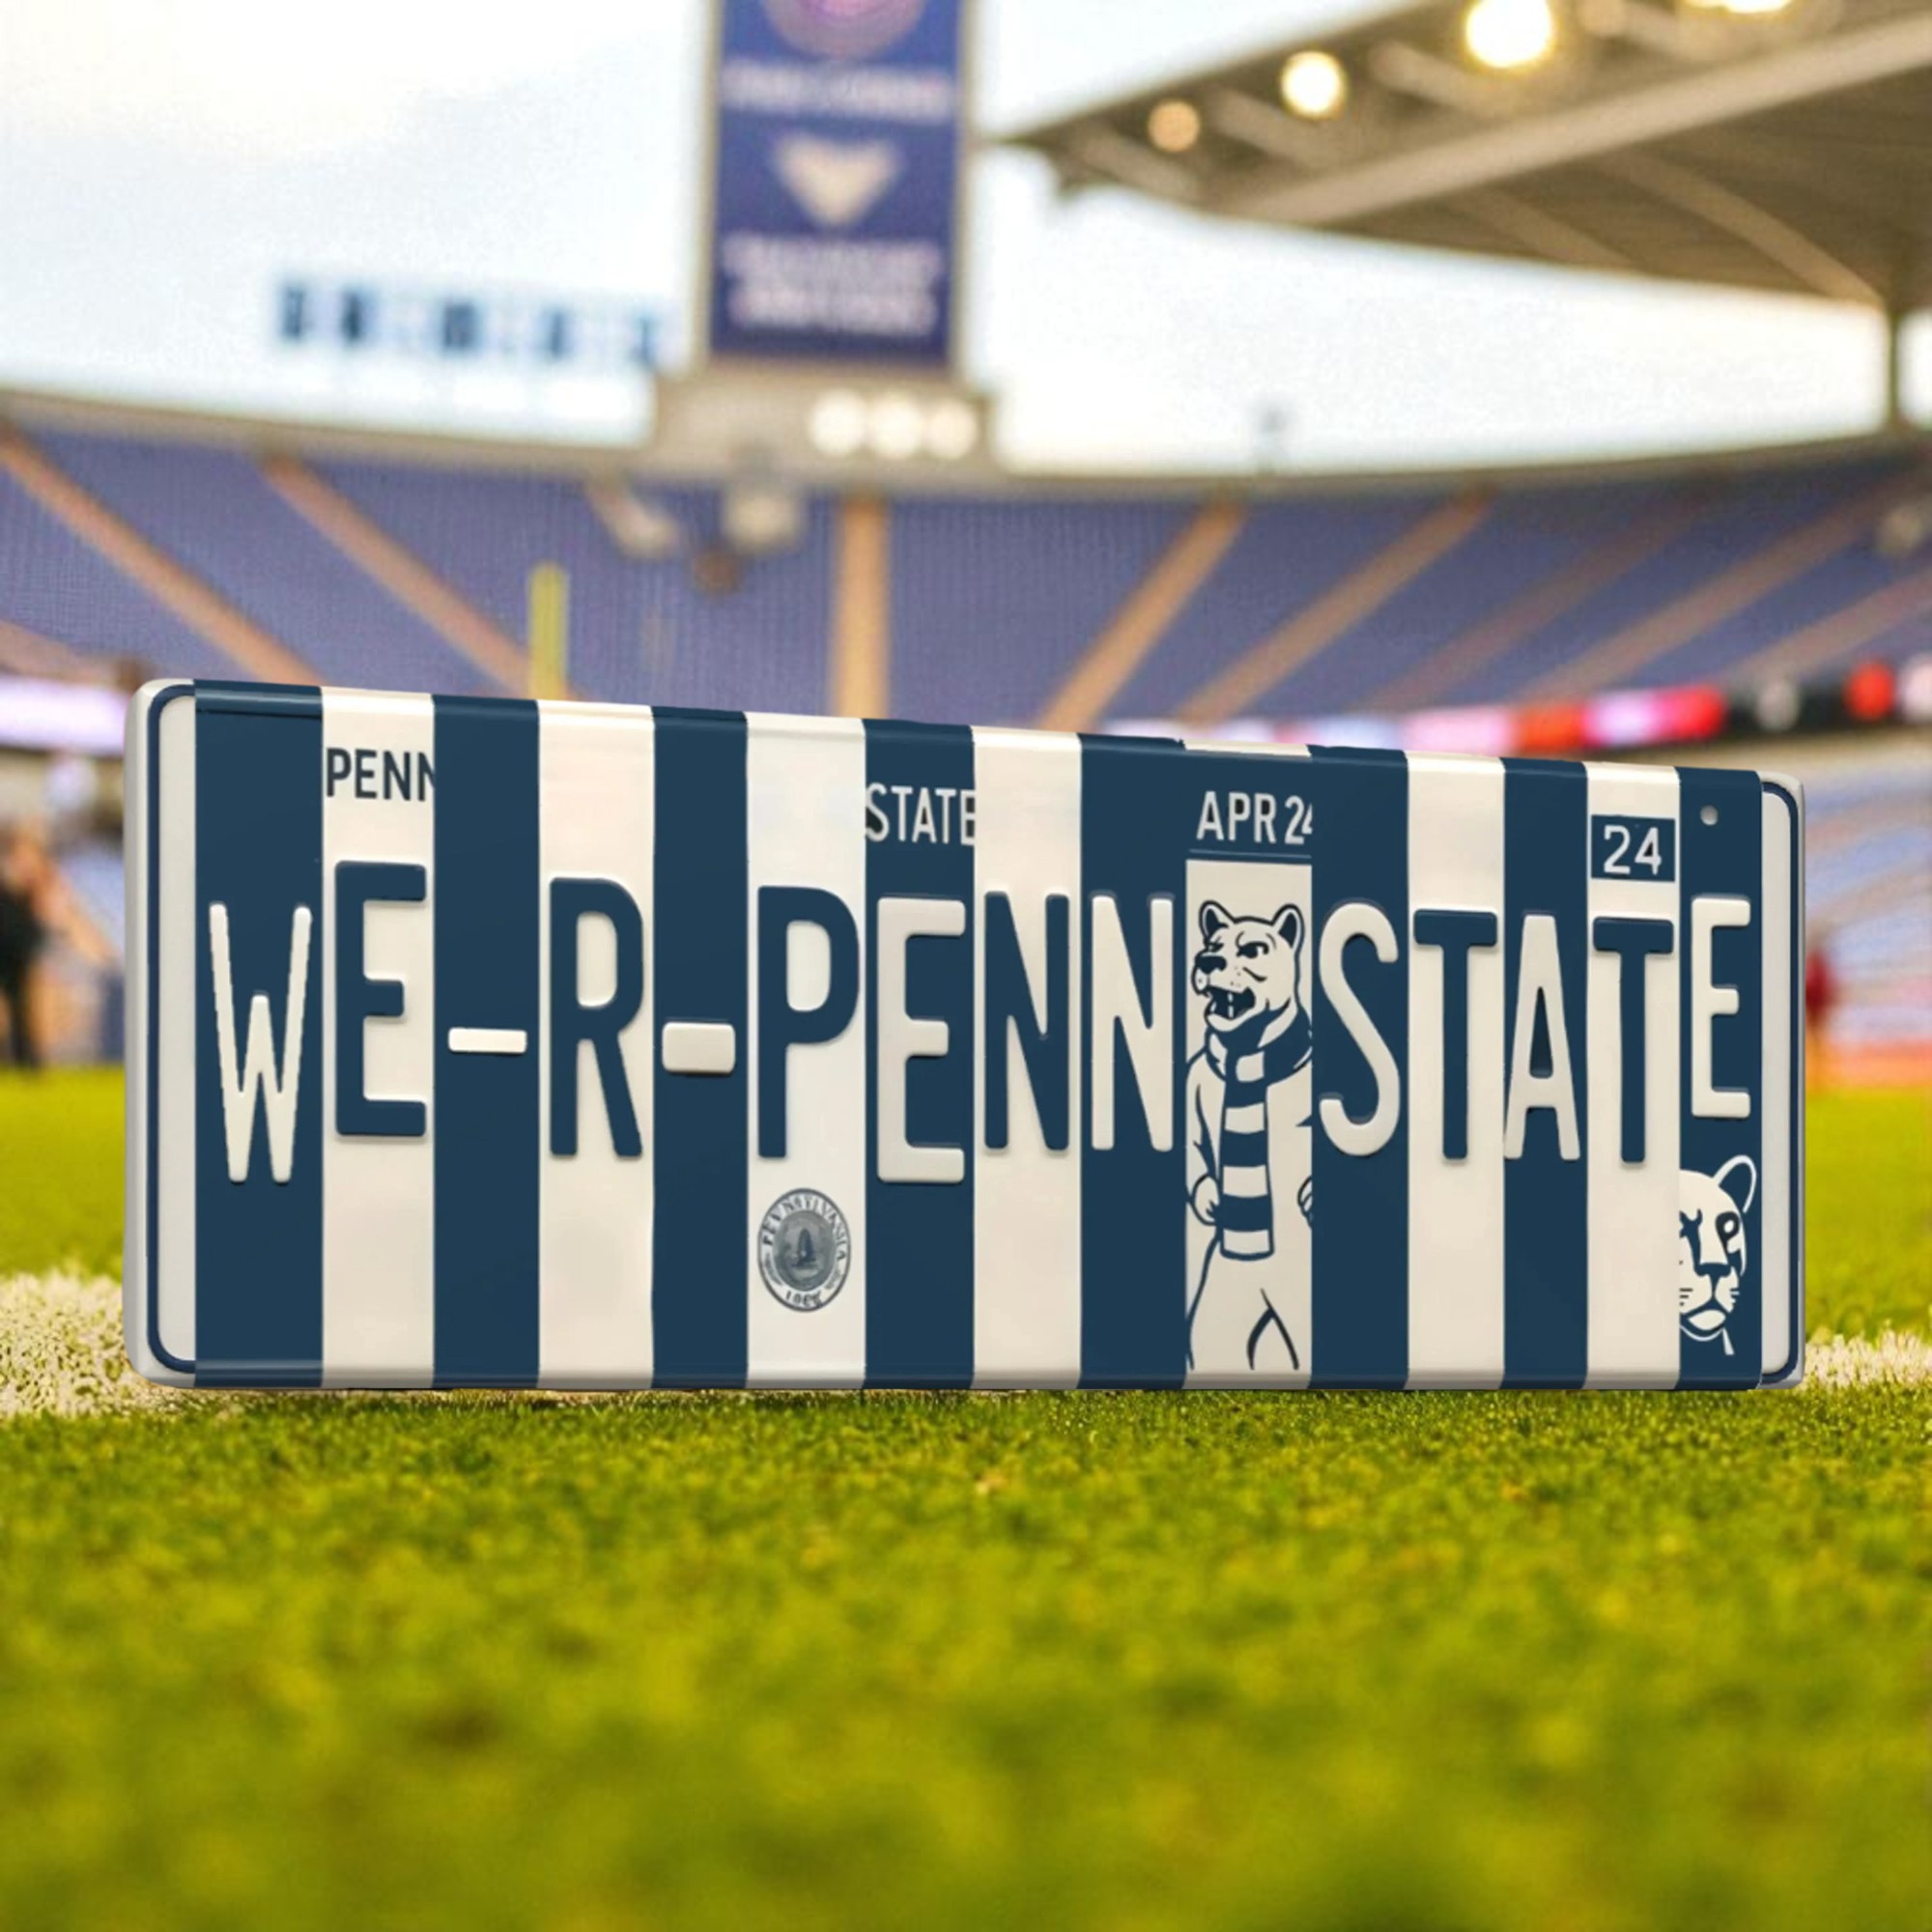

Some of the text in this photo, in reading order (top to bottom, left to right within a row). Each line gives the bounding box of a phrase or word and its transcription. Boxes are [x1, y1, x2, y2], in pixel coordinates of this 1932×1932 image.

[327, 747, 976, 846] PENN STATE
[1196, 790, 1277, 843] APR
[1604, 824, 1662, 875] 24
[208, 859, 1752, 1185] WE-R-PENN STATE
